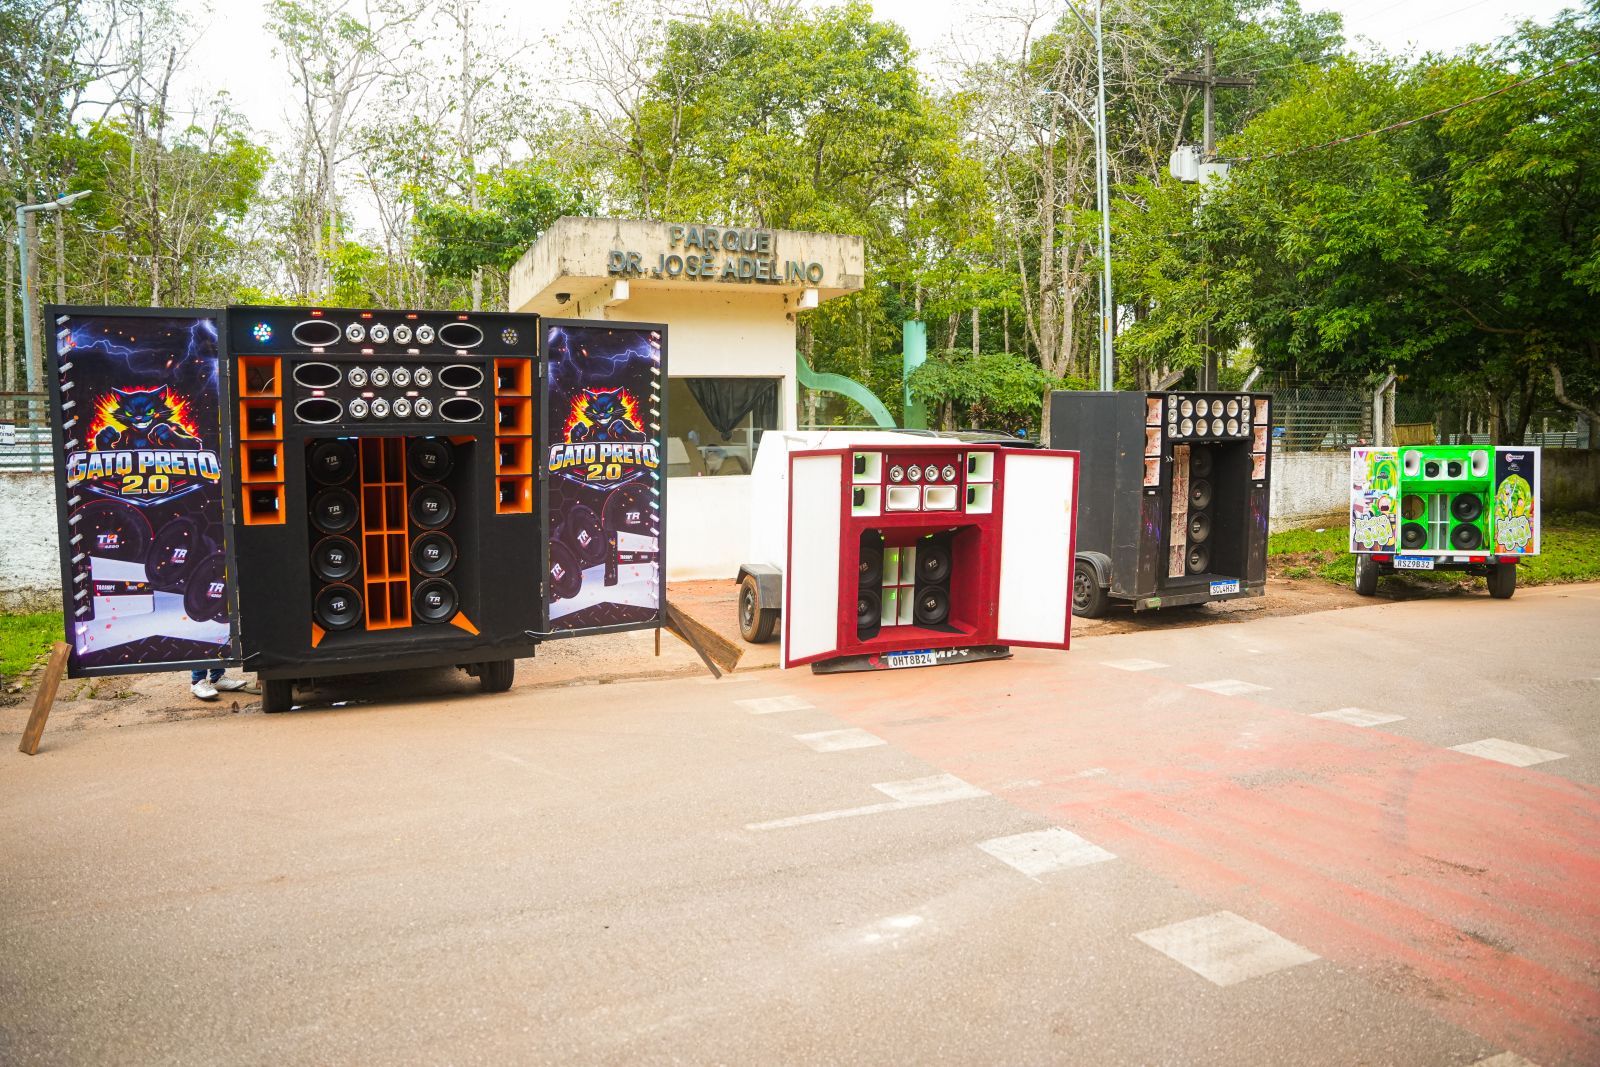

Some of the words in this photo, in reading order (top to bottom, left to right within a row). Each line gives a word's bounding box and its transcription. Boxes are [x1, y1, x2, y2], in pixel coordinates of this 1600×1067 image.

[670, 226, 771, 253] PARQUE
[608, 250, 648, 274] DR.
[721, 255, 824, 282] ADELINO
[548, 444, 596, 471] GATO
[600, 444, 658, 469] PRETO
[67, 451, 133, 481] GATO
[138, 451, 221, 480] PRETO
[587, 464, 621, 481] 2.0
[121, 475, 169, 495] 2.0
[626, 512, 640, 520] TR
[577, 530, 589, 544] TR
[174, 548, 188, 558] TR
[550, 563, 563, 577] TR
[1397, 560, 1430, 569] RSZ9B32
[209, 582, 225, 592] TR
[332, 601, 344, 609] TR
